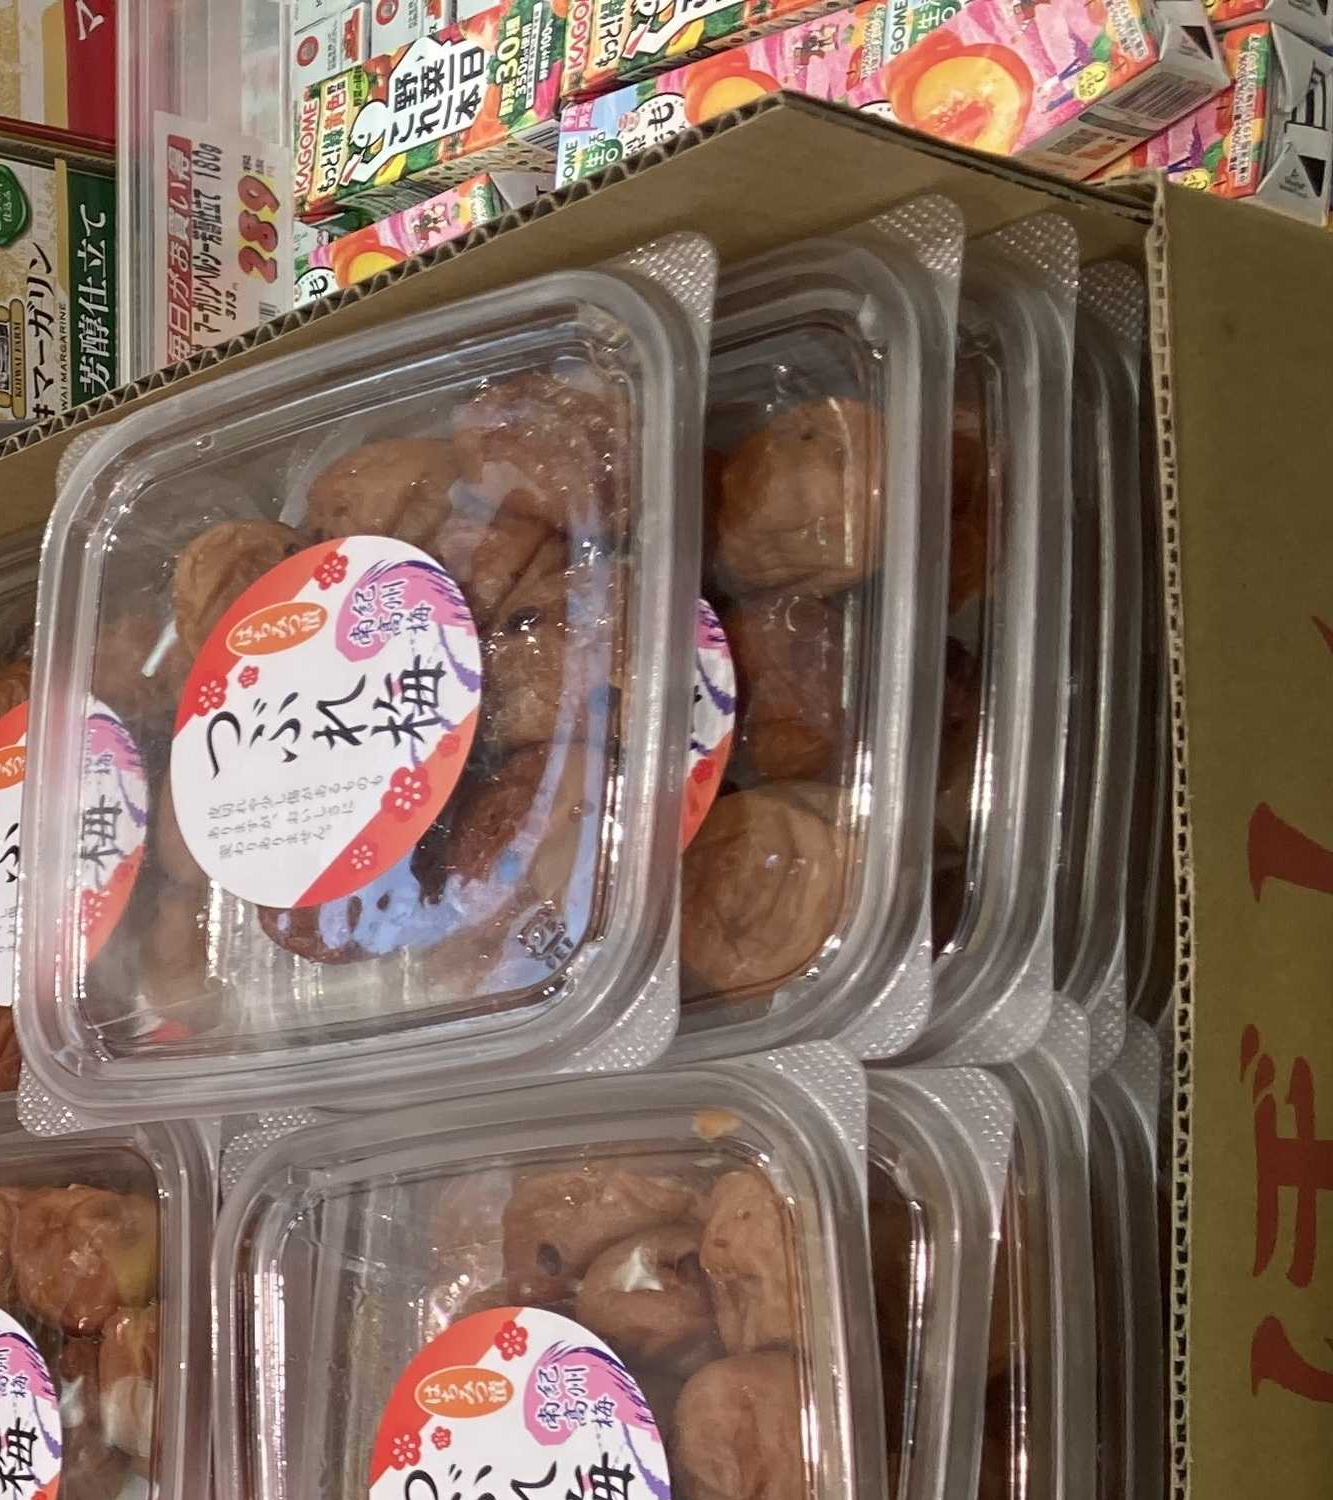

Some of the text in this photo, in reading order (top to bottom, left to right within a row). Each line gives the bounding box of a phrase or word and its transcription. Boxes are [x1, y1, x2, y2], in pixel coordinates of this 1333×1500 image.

[192, 143, 223, 180] 180g
[292, 99, 318, 197] KAGOME
[167, 146, 191, 362] 毎日がお買い得
[237, 175, 279, 284] 289
[58, 303, 68, 383] MARGARINE
[204, 654, 446, 780] つぶれ梅
